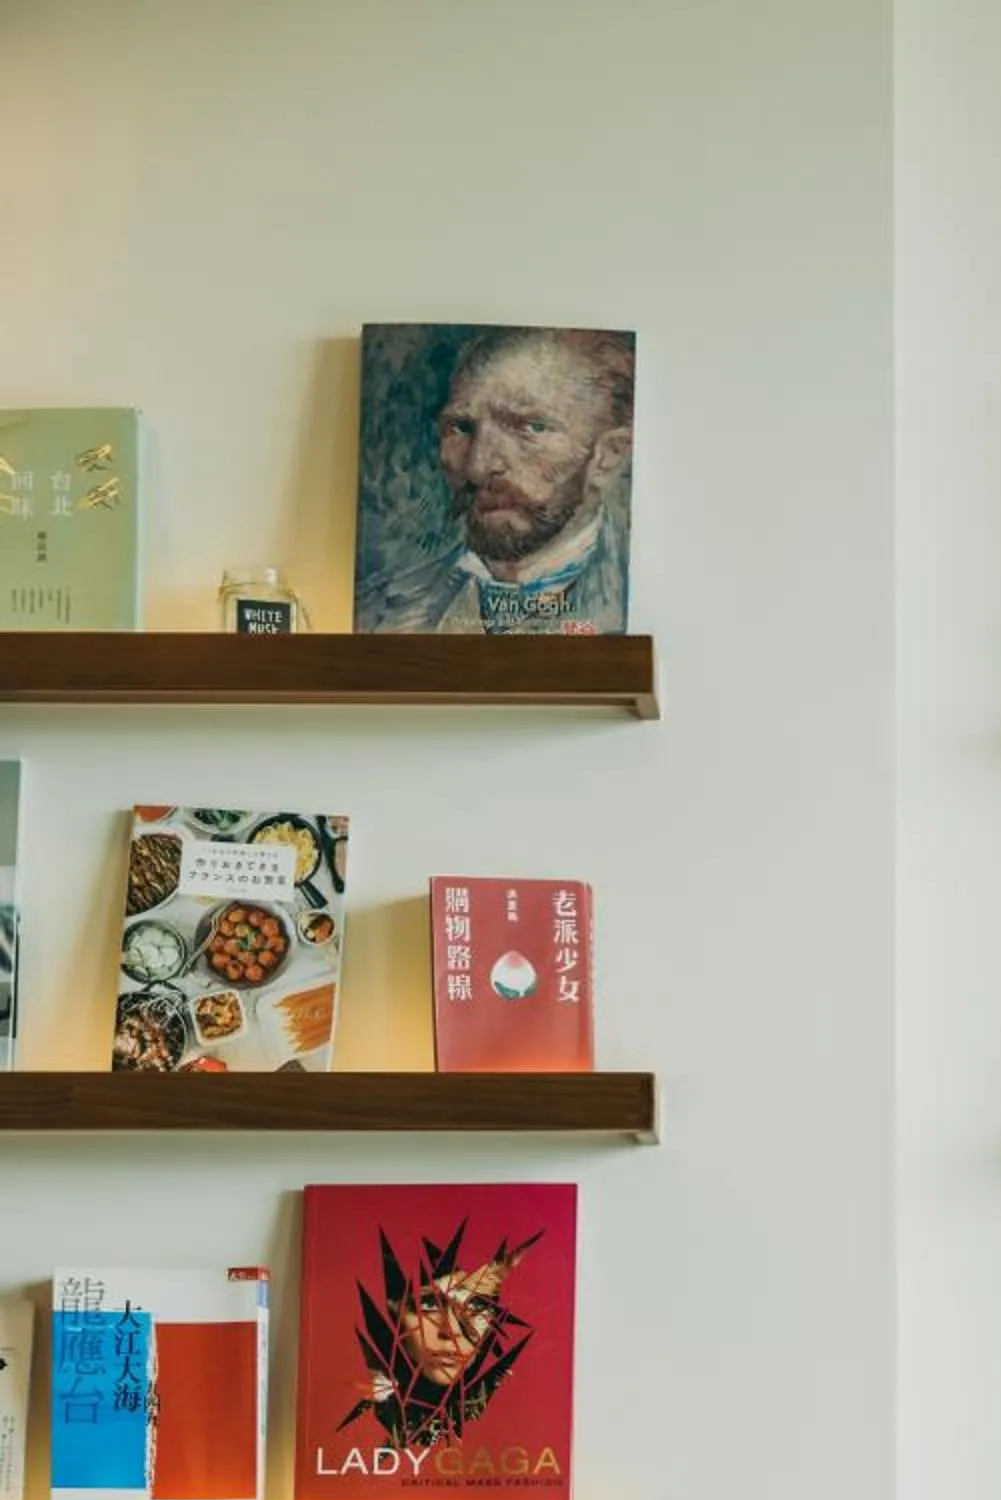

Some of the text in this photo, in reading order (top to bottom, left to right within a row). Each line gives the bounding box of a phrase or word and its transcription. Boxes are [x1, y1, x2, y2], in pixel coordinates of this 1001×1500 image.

[243, 608, 283, 622] WHITE
[488, 598, 519, 613] Van
[445, 887, 473, 1001] 購物路線
[553, 889, 580, 1003] 老派少女
[58, 1277, 106, 1425] 龍應台
[113, 1300, 143, 1412] 大江大海
[316, 1447, 561, 1475] LADY GAGA
